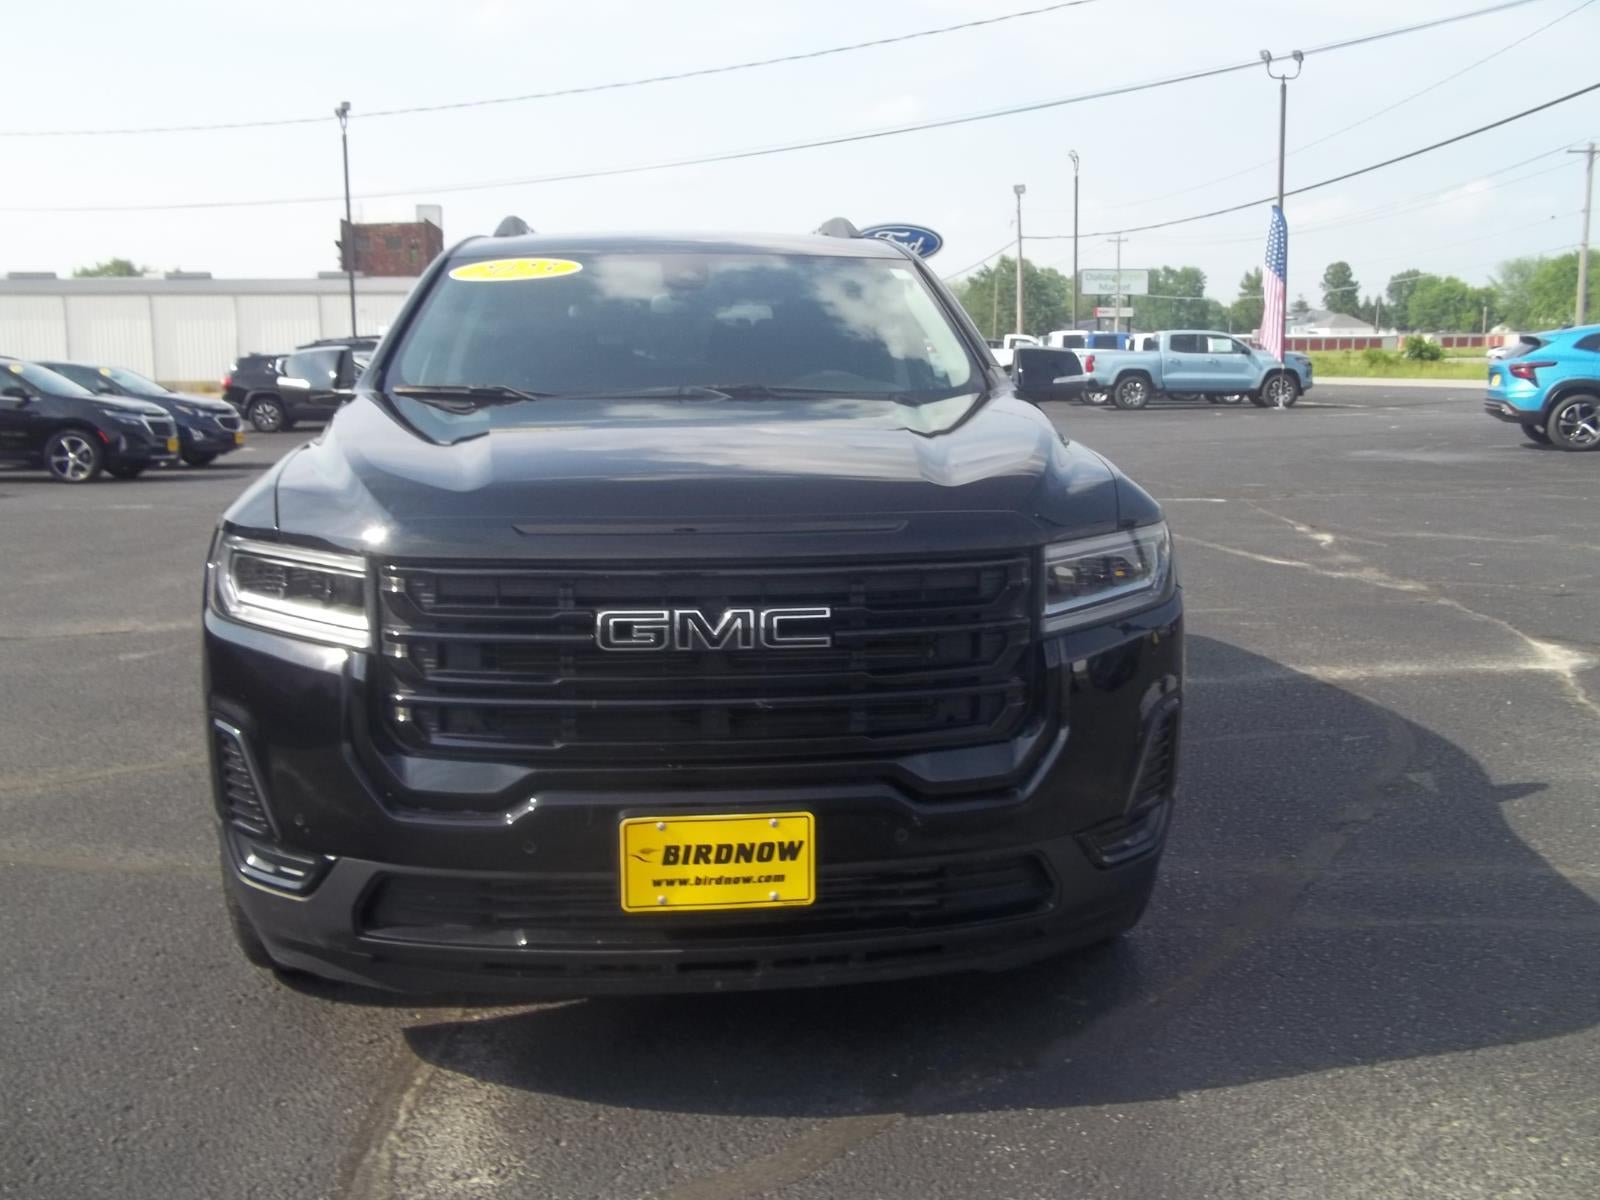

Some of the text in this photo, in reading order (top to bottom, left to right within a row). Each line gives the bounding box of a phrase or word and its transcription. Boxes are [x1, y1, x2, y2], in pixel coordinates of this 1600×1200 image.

[596, 607, 831, 650] GMC
[661, 840, 804, 866] BIRDNOW
[652, 874, 785, 887] www.birdnow.com
